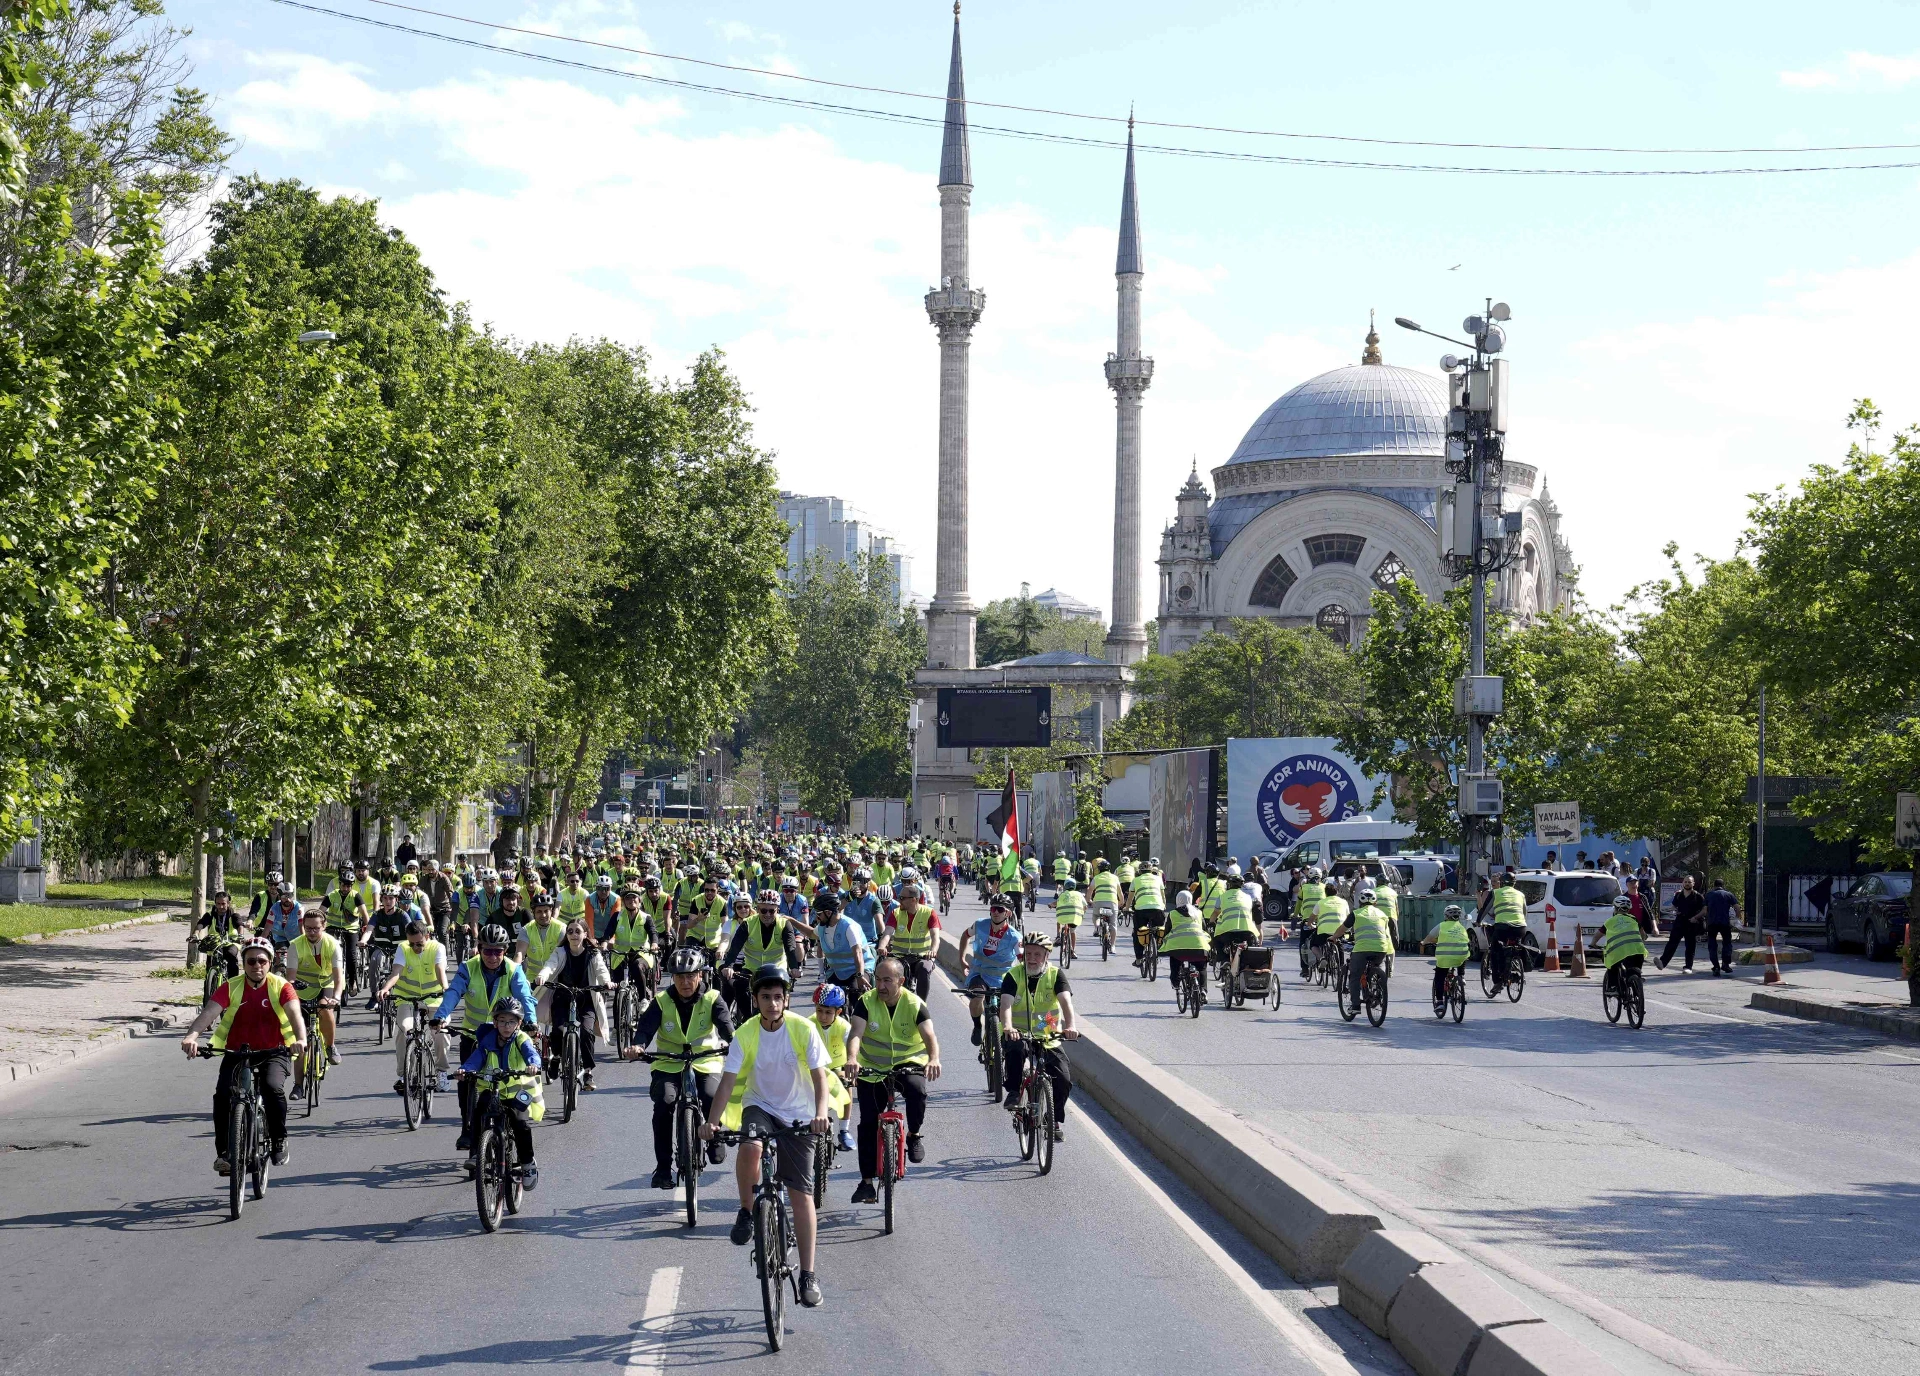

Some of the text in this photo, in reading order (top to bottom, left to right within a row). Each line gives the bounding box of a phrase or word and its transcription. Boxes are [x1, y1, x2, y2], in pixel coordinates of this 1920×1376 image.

[1267, 759, 1348, 792] ZOR ANINDA
[1538, 811, 1576, 821] YAYALAR
